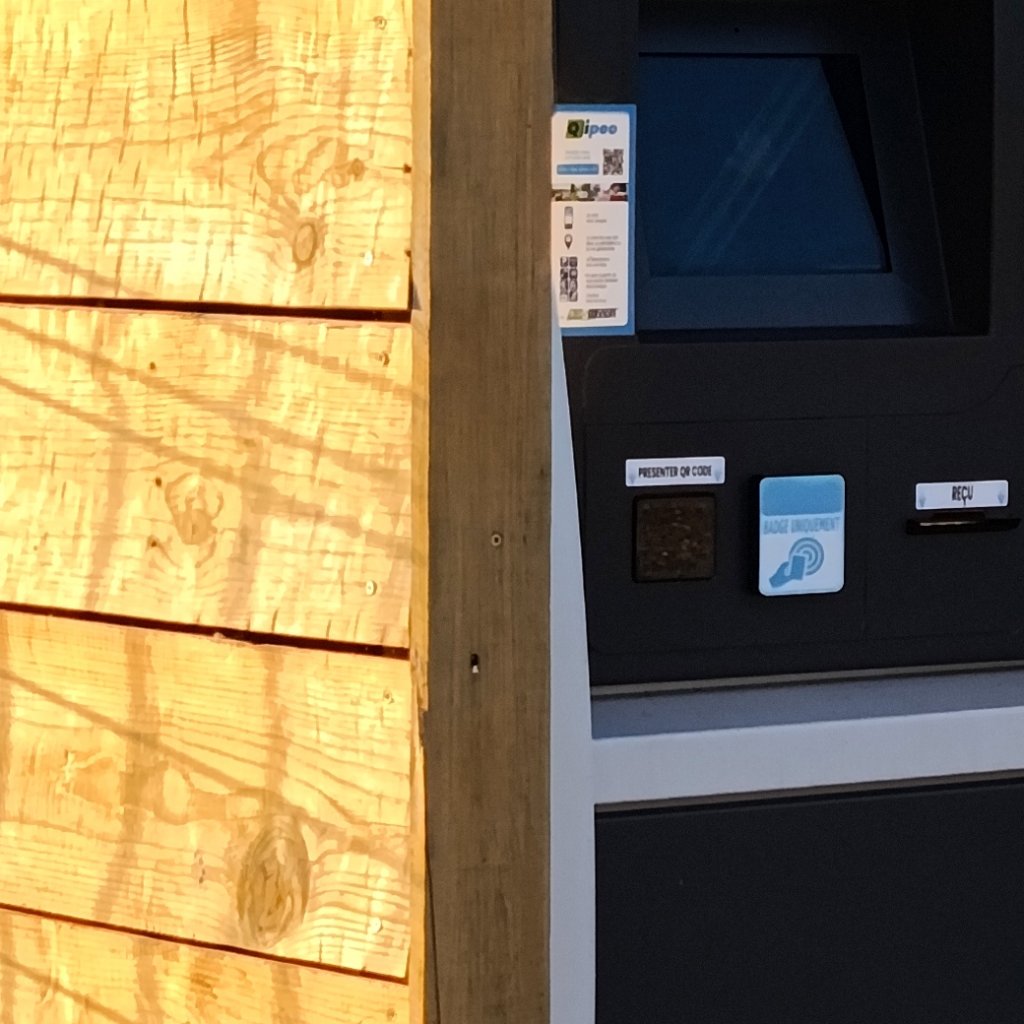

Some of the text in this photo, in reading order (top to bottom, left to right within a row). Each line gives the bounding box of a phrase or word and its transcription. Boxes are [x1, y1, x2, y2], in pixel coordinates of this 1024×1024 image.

[638, 465, 712, 479] PRESENTER QR CODE
[951, 485, 974, 506] REÇU
[763, 516, 841, 535] BADGE UNIQUEMENT
